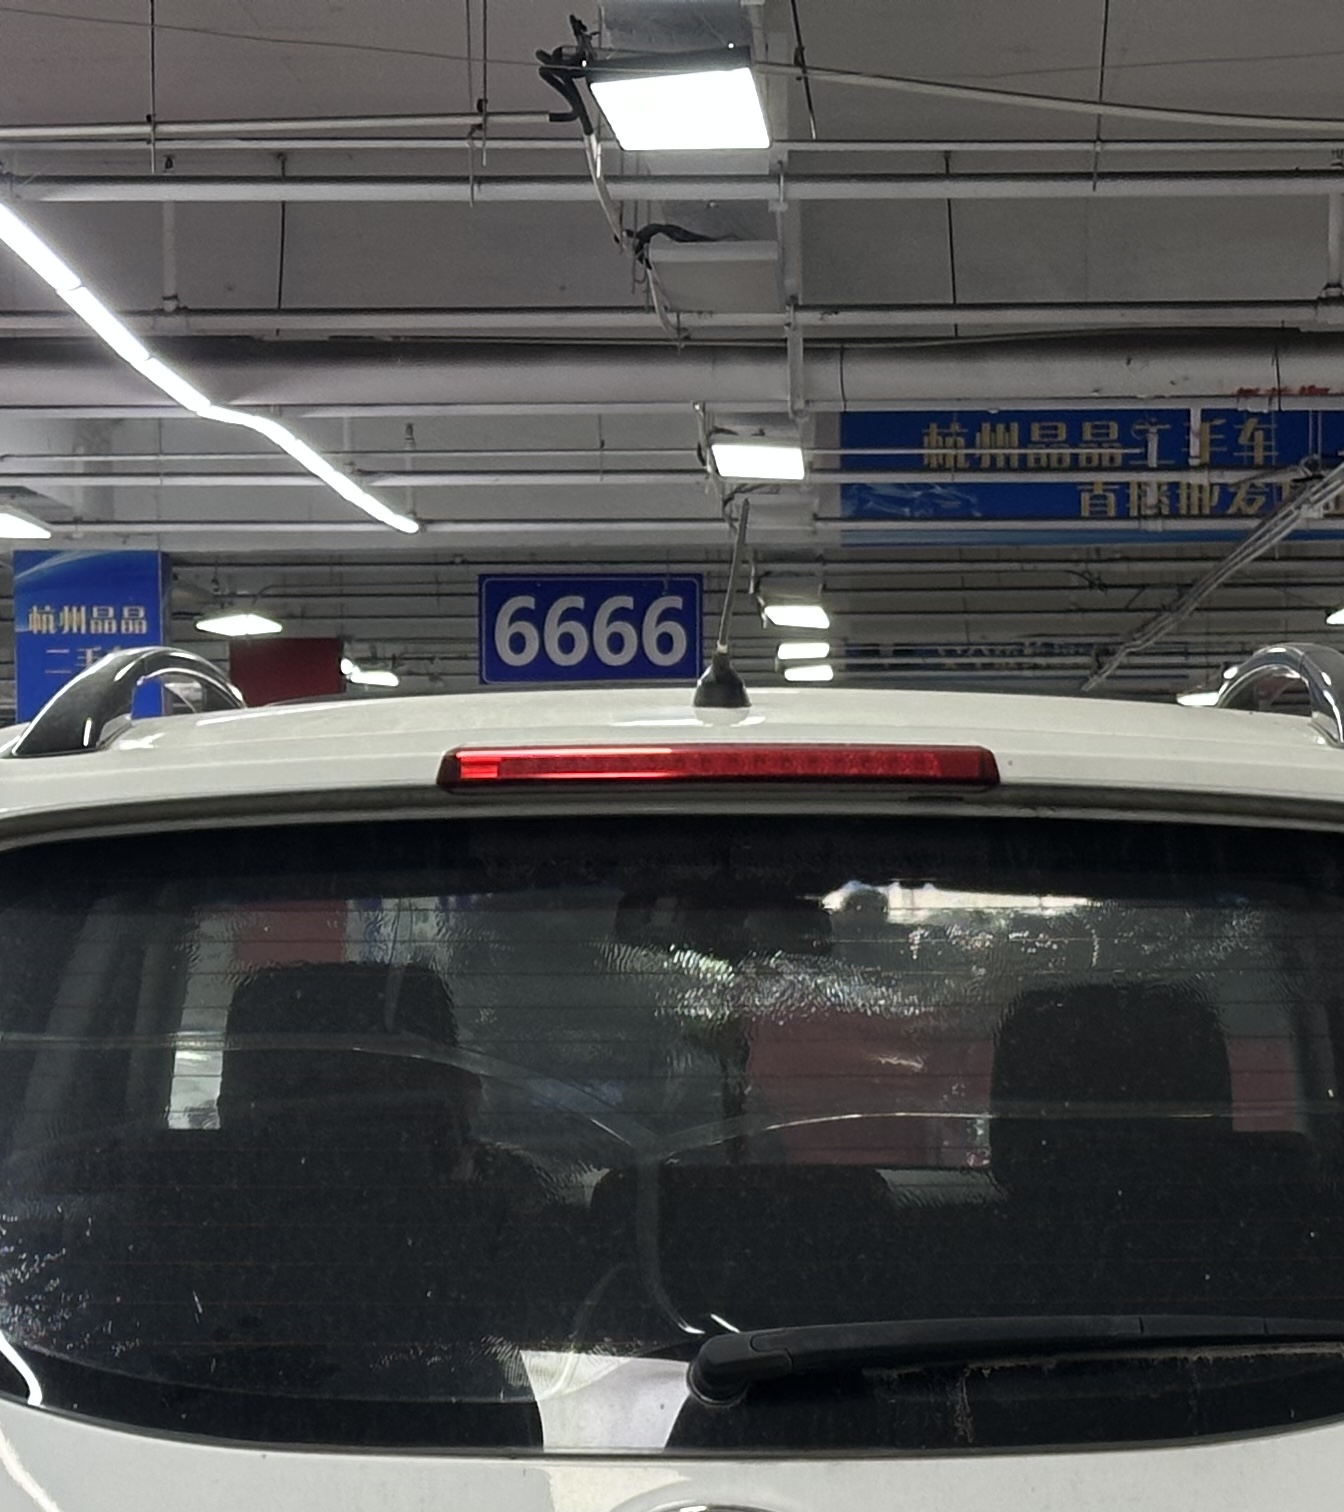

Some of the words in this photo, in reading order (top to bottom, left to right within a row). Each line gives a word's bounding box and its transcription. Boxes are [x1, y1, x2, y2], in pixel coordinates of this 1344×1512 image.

[922, 417, 1278, 468] 杭州晶晶二手车
[28, 605, 148, 635] 杭州晶晶
[494, 595, 687, 667] 6666
